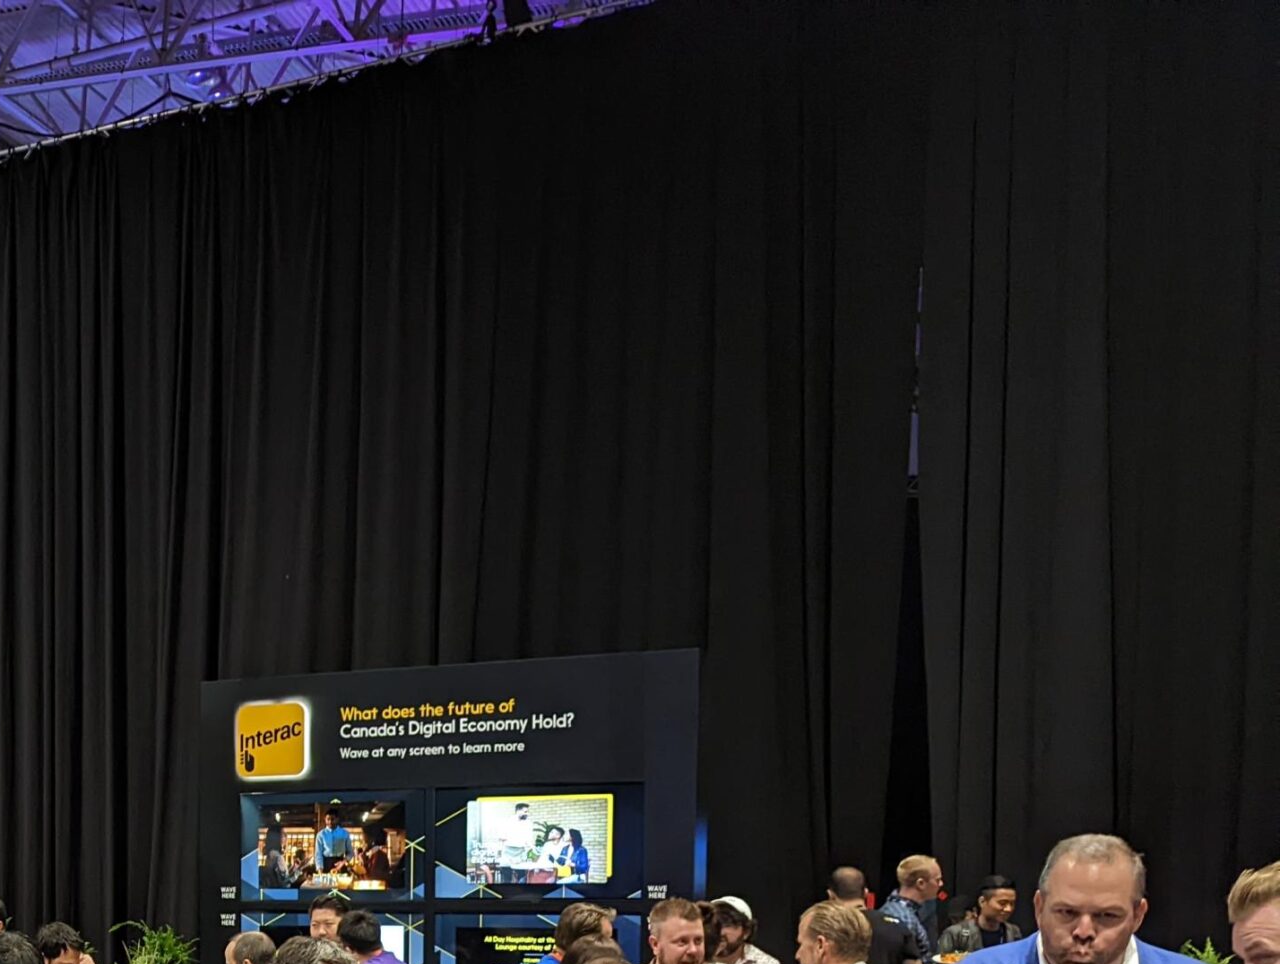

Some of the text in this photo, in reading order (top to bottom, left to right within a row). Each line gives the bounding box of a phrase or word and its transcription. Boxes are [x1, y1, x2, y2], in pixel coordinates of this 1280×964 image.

[340, 698, 516, 722] What does the future of
[340, 712, 574, 738] Canada's Digital Economy Hold?
[240, 721, 302, 752] Interac
[339, 742, 525, 759] Wave at any screen to learn more
[647, 884, 668, 892] WAVE
[484, 935, 492, 943] All
[493, 936, 506, 945] Day
[506, 935, 536, 945] Hospitality
[537, 936, 546, 944] at
[495, 943, 552, 952] Lounge courtesy of
